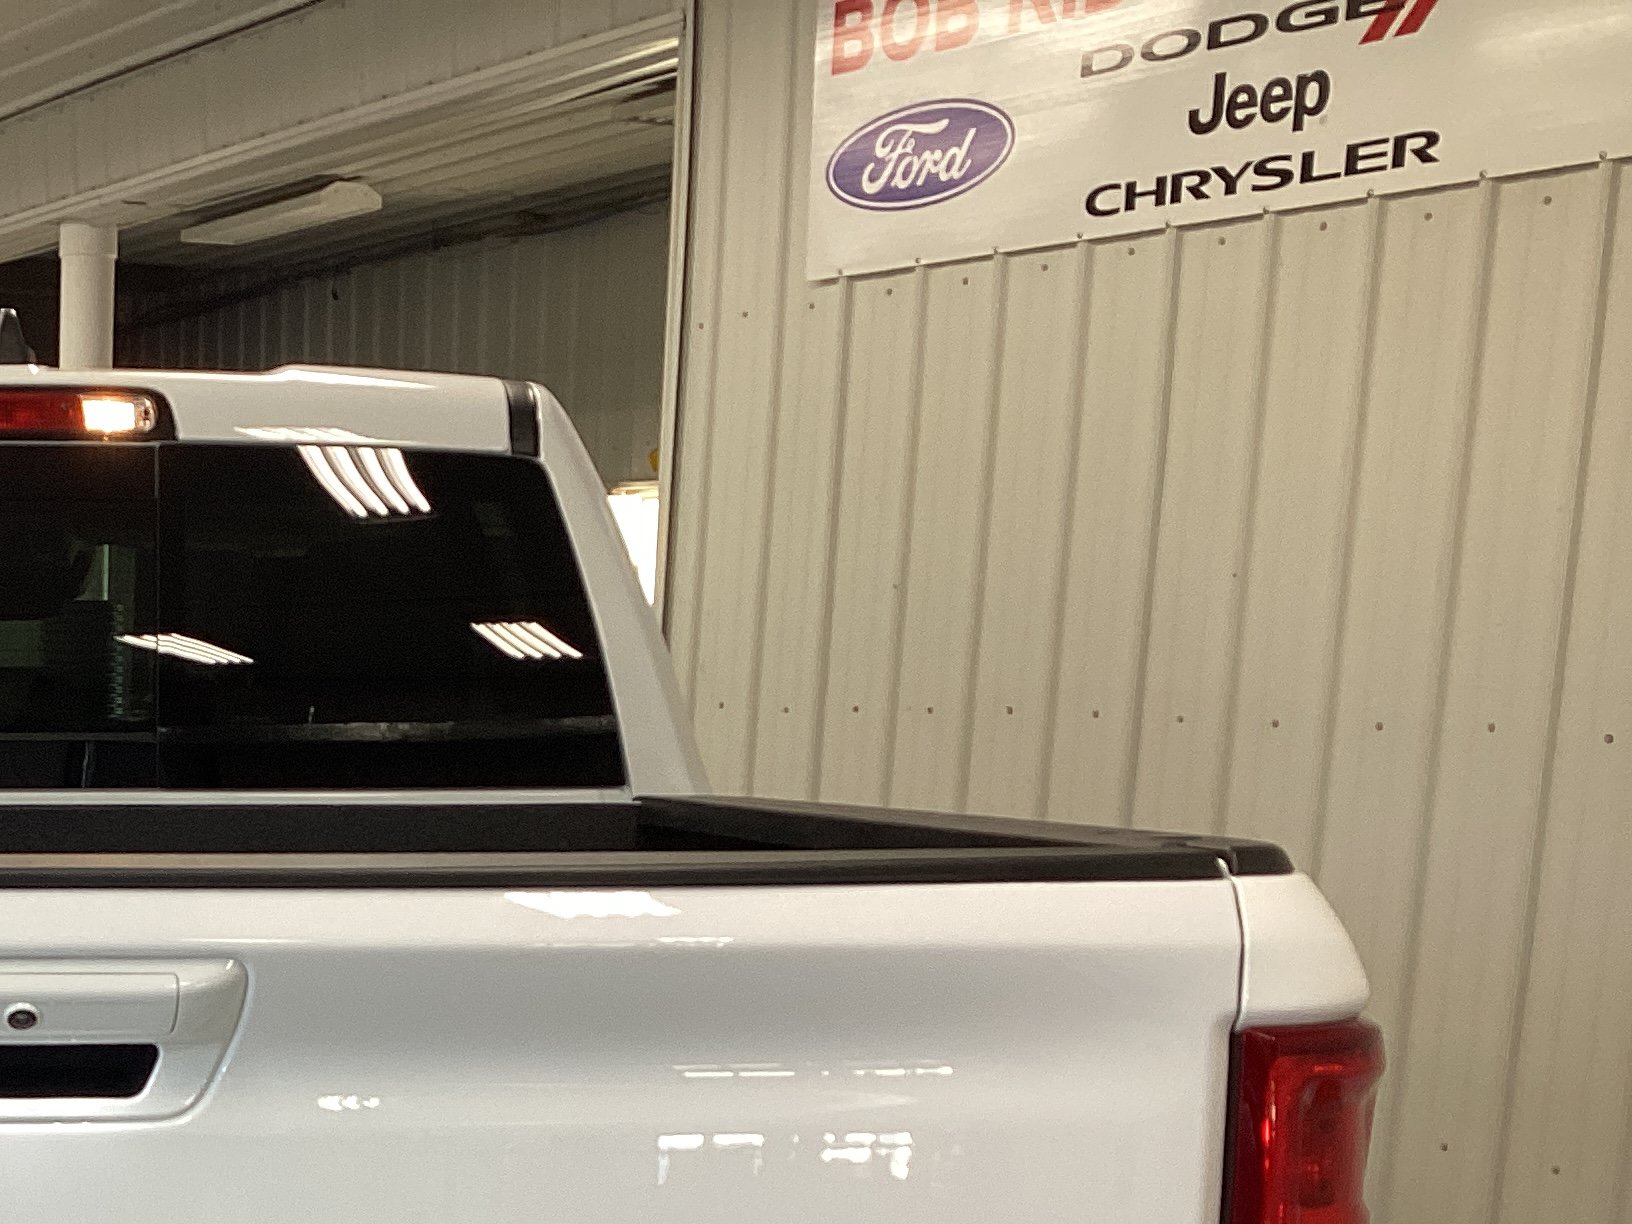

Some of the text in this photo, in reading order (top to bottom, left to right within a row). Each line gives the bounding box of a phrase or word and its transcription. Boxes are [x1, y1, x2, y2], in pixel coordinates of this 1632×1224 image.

[831, 0, 980, 76] BOB
[1187, 69, 1331, 135] Jeep
[861, 118, 977, 195] Ford
[1084, 130, 1441, 218] CHRYSLER
